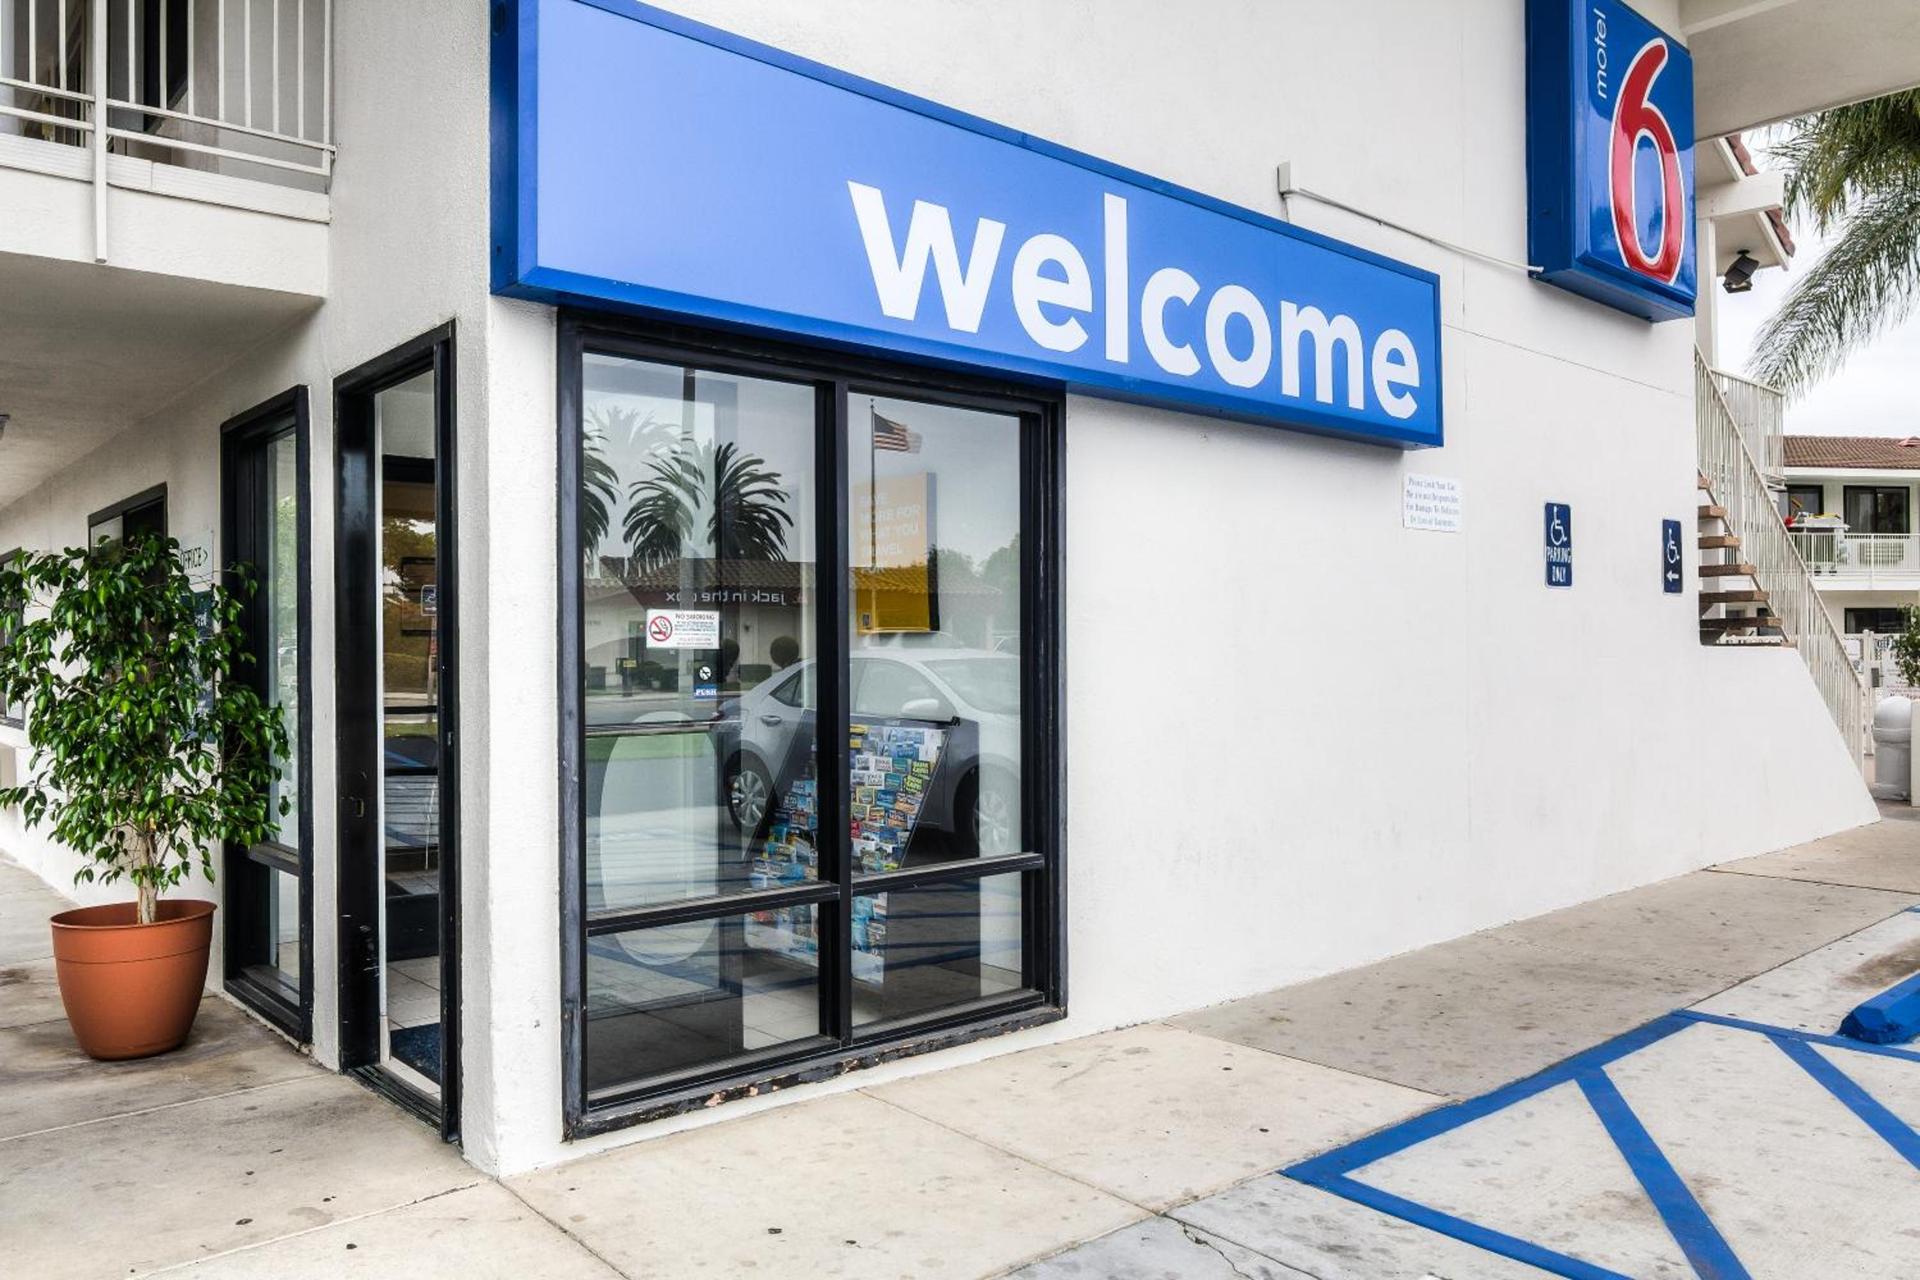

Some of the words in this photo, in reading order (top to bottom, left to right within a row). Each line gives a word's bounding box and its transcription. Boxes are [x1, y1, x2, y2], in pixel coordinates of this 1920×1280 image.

[1593, 8, 1607, 99] motel
[1608, 37, 1686, 287] 6
[847, 181, 1420, 420] welcome
[1547, 546, 1571, 564] PARKING
[1552, 565, 1567, 583] ONLY
